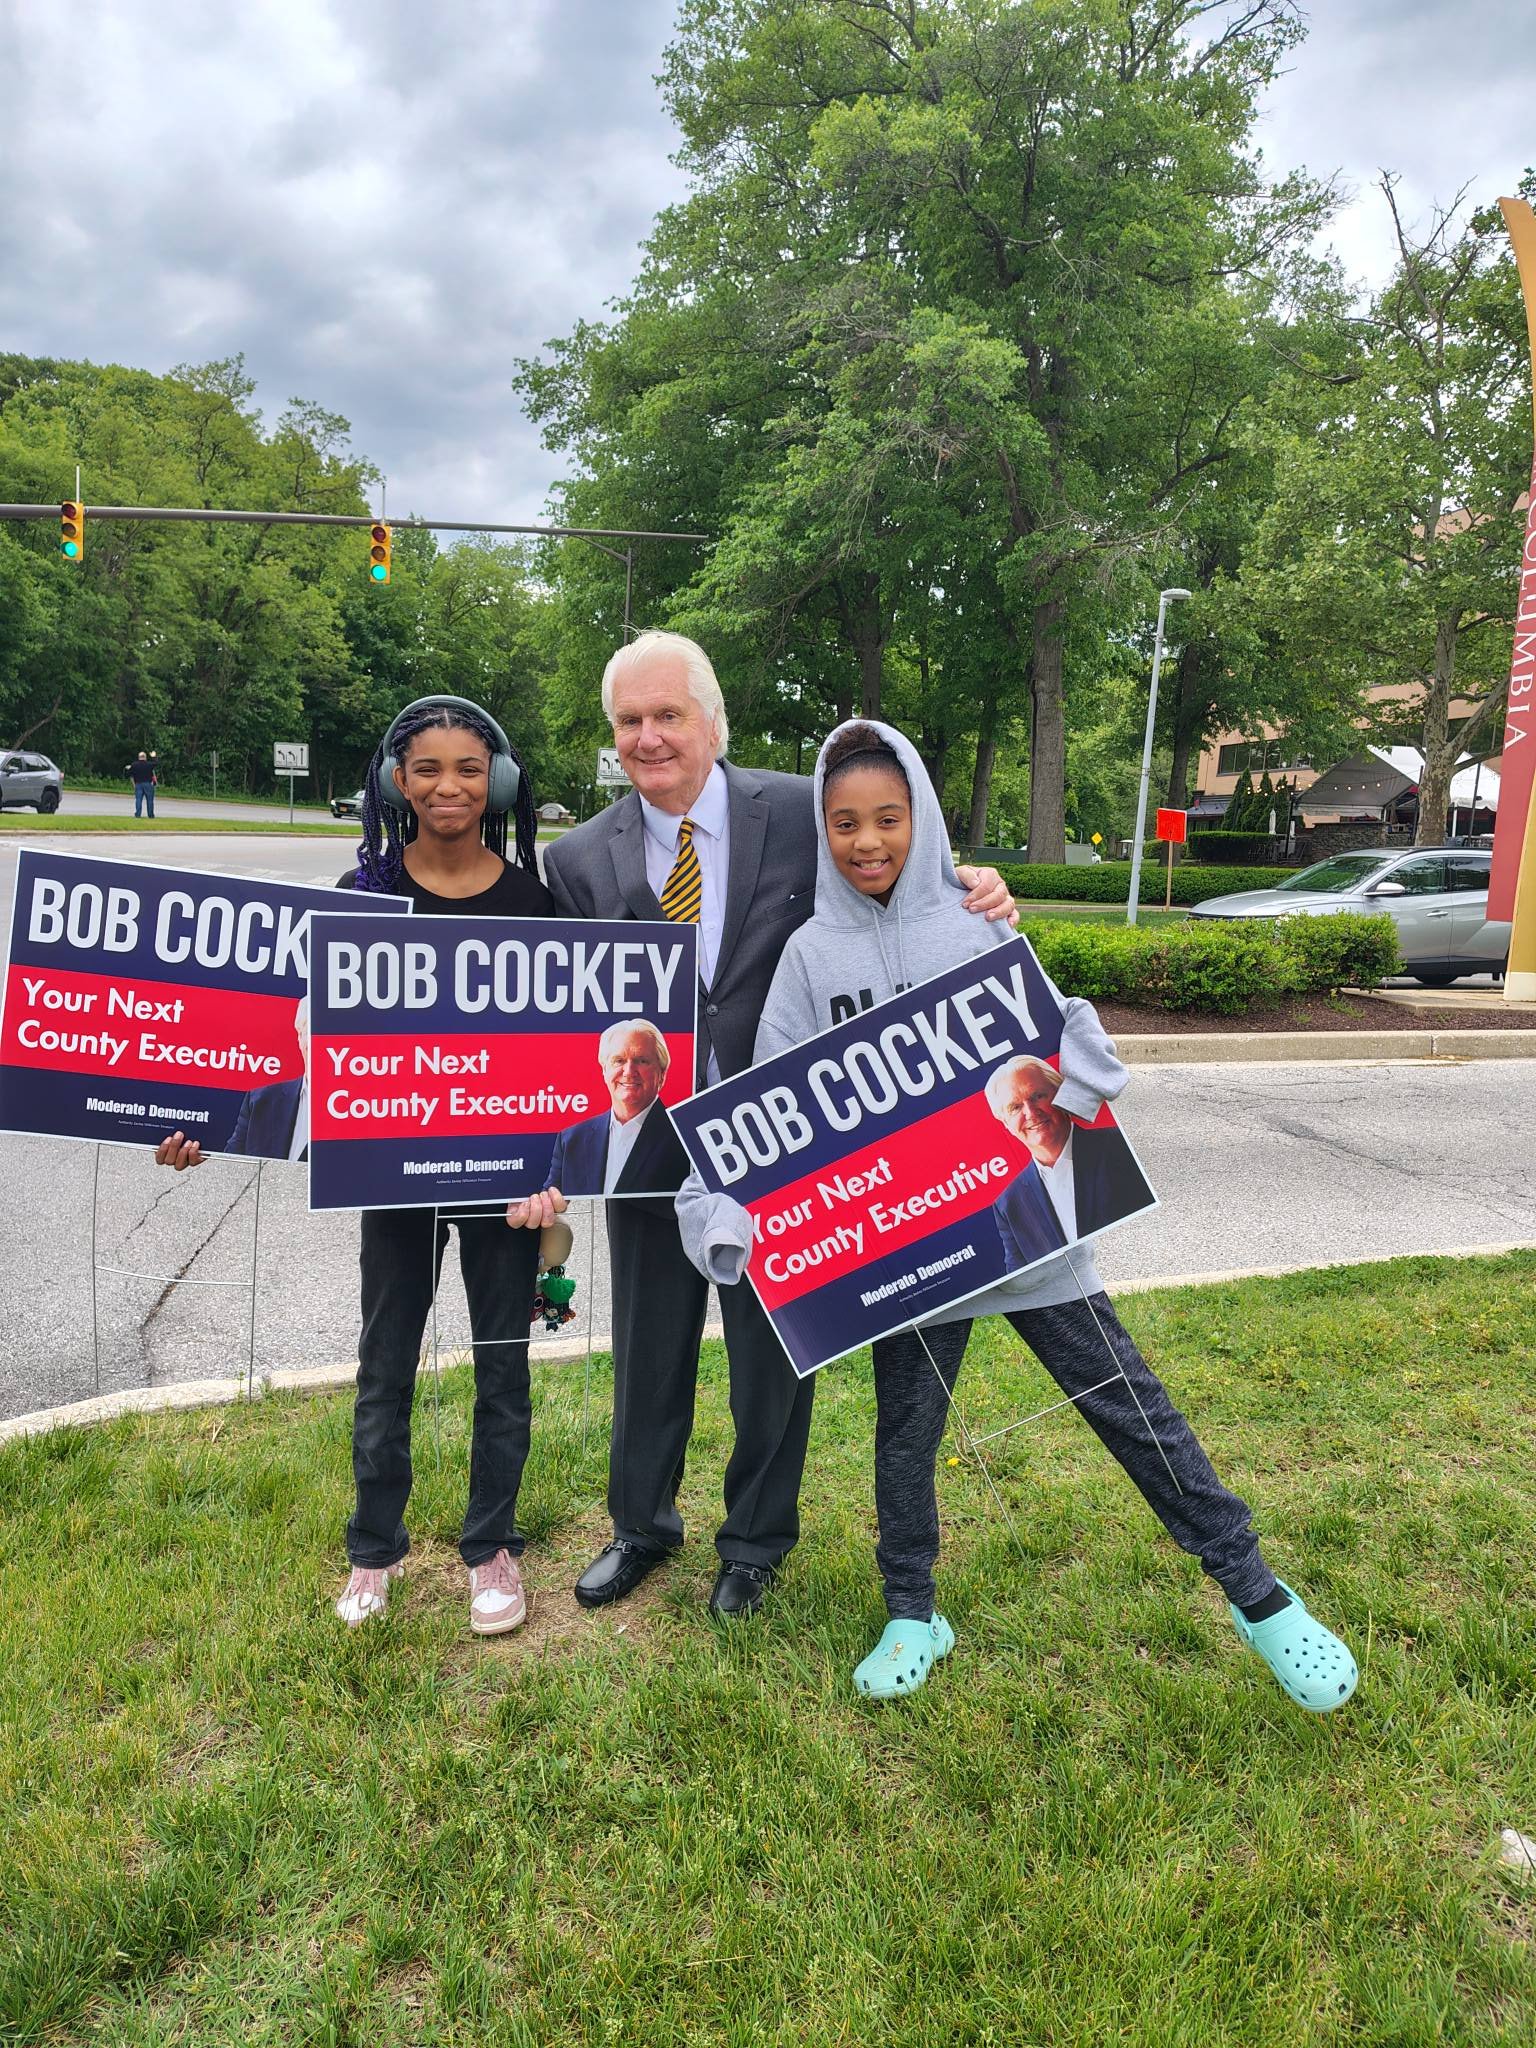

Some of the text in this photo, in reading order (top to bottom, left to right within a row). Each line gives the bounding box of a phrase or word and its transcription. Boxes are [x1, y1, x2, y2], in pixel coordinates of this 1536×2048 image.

[28, 877, 141, 953] BOB
[22, 978, 185, 1023] Your Next
[327, 938, 684, 1014] BOB COCKEY
[17, 1020, 282, 1075] County Executive
[326, 1046, 490, 1077] Your Next
[696, 962, 1040, 1186] BOB COCKEY
[86, 1097, 209, 1123] Moderate Democrat
[326, 1085, 589, 1126] County Executive
[403, 1157, 524, 1176] Moderate Democrat
[753, 1157, 894, 1244] Your Next
[764, 1156, 1009, 1283] County Executive
[860, 1274, 918, 1307] Moderate
[916, 1244, 976, 1281] Democrat
